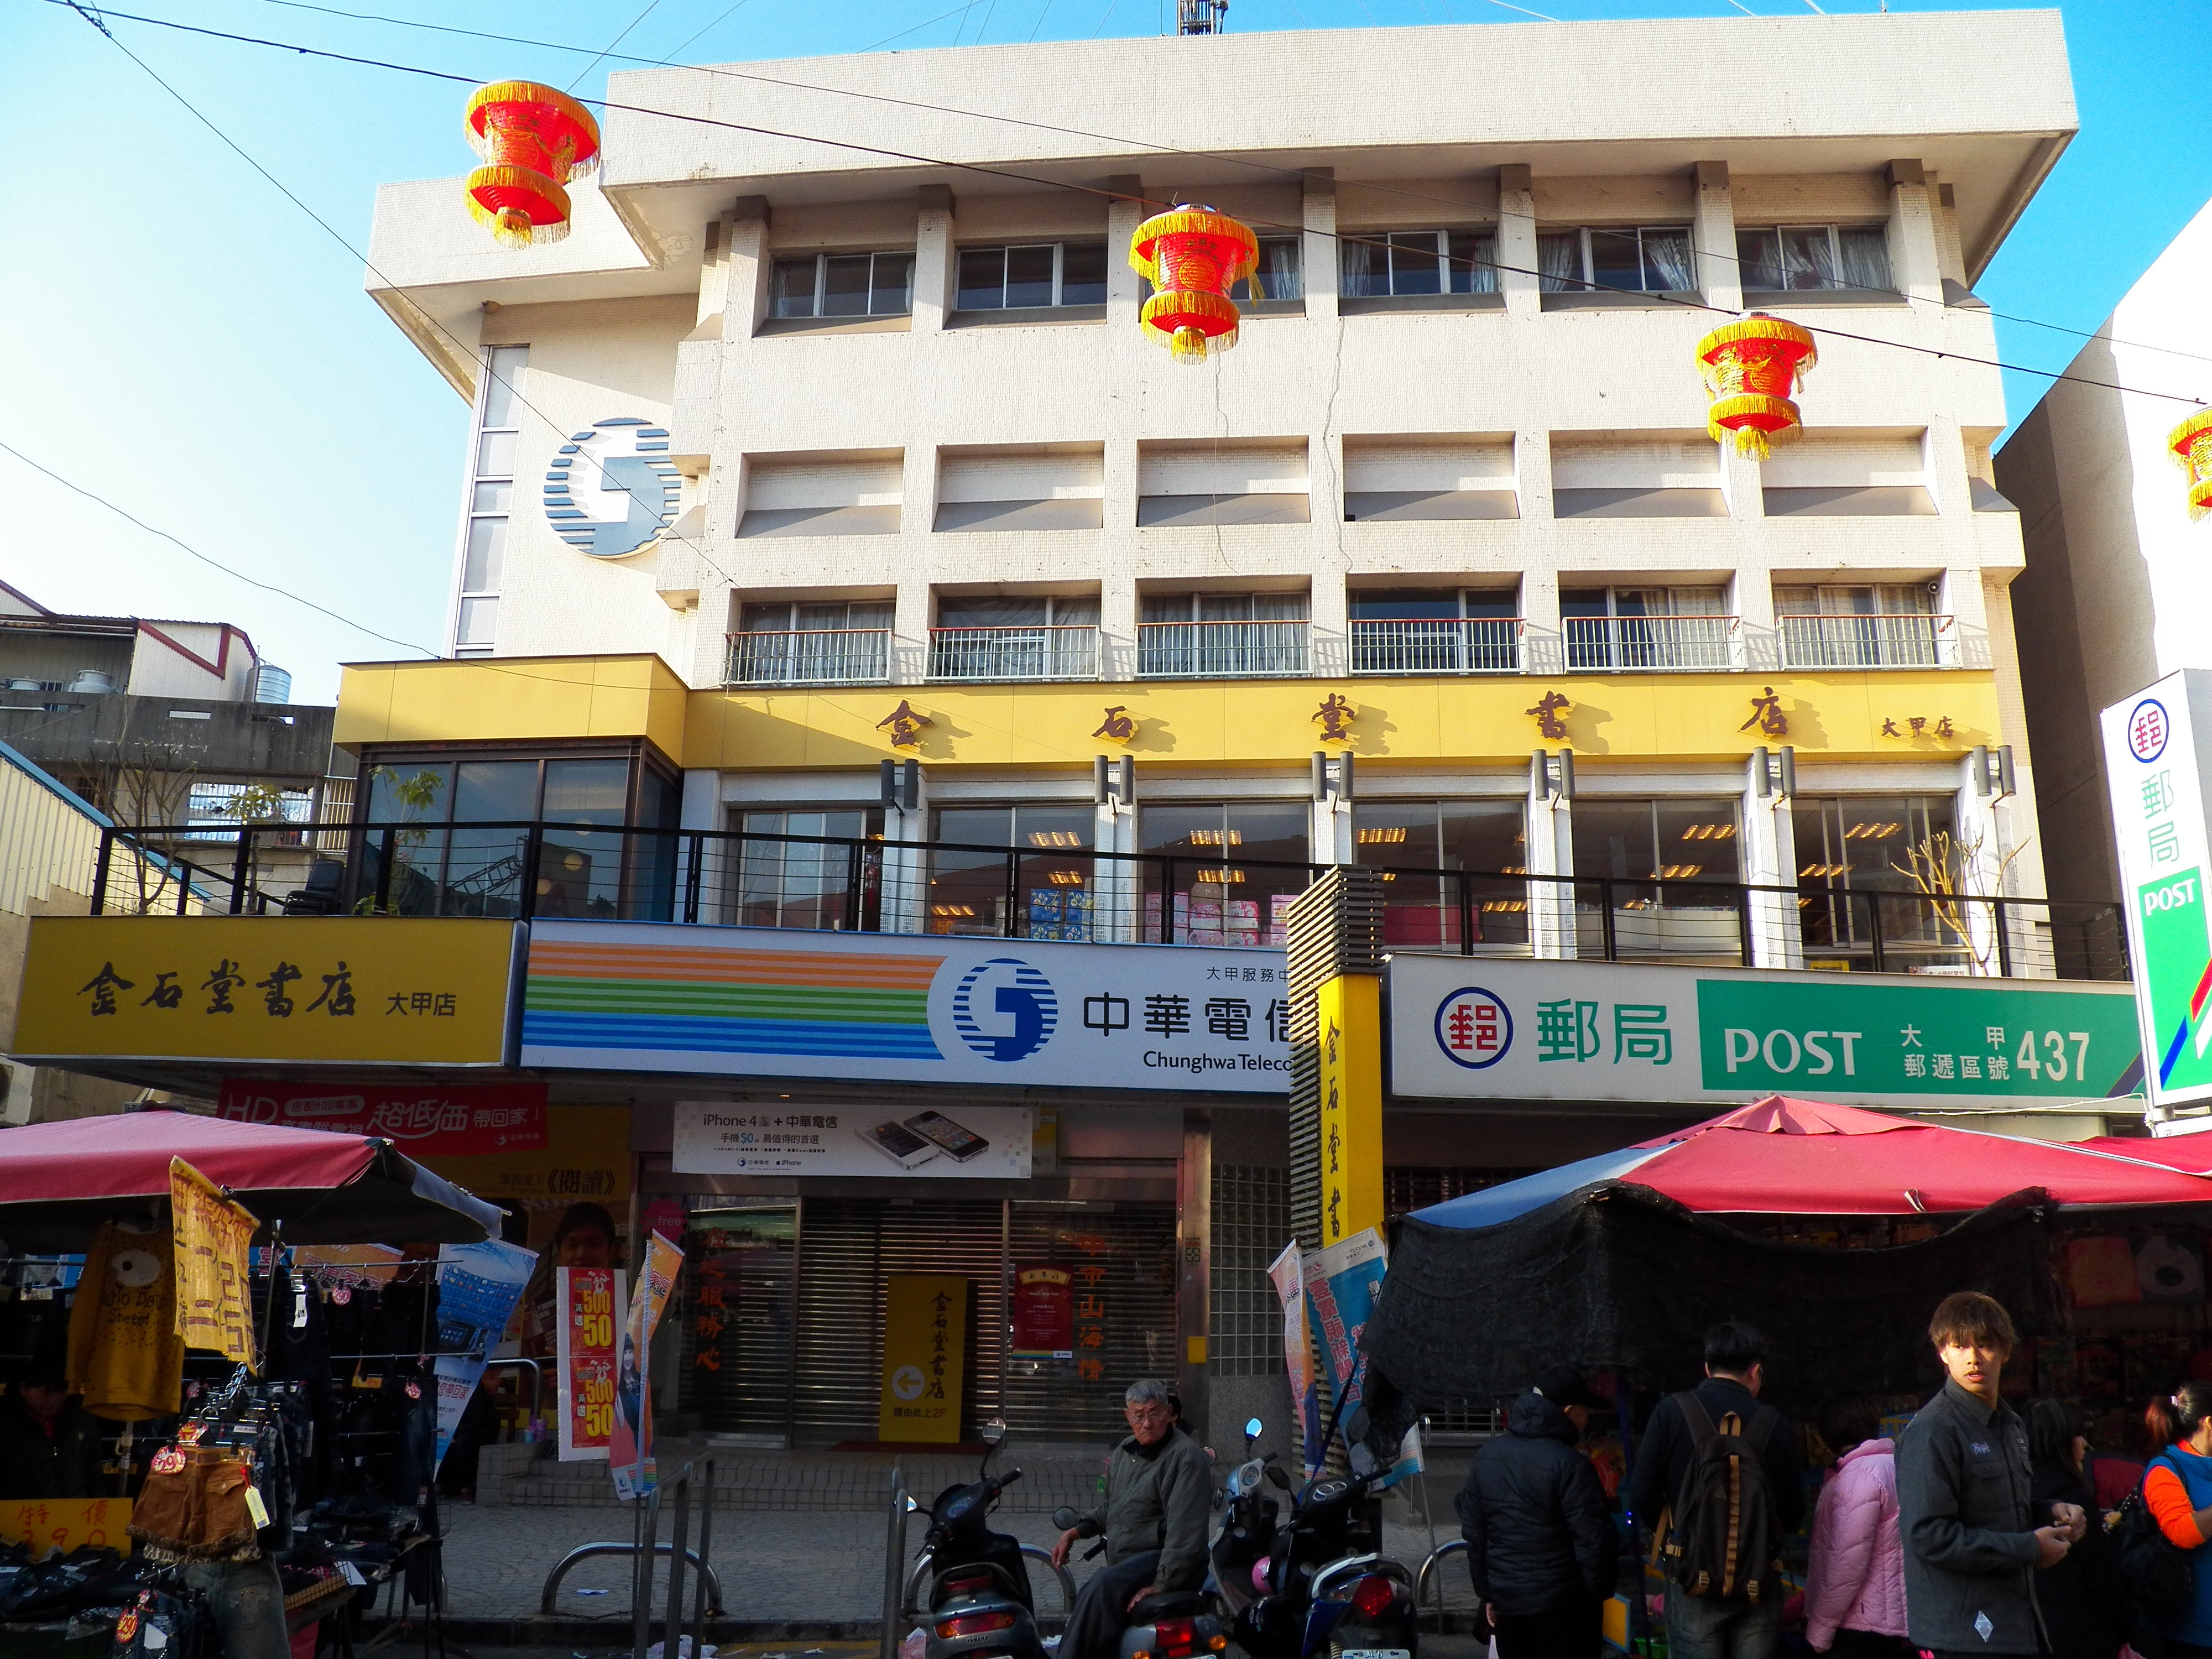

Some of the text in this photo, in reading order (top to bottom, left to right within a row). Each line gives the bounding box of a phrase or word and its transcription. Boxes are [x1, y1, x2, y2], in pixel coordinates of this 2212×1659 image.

[875, 687, 1954, 748] 金石堂書店 大甲店
[2135, 708, 2162, 753] 郵
[2141, 768, 2180, 869] 郵局
[2144, 877, 2196, 916] POST
[78, 959, 457, 1018] 金石堂書店 大甲店
[1448, 1004, 1499, 1051] 郵
[1537, 998, 1673, 1065] 郵局
[1144, 1051, 1237, 1074] Chunghwa
[1724, 1028, 1863, 1076] POST
[1904, 1053, 2010, 1081] 郵遞區號
[2016, 1030, 2090, 1082] 437
[224, 1093, 279, 1124] HD
[703, 1114, 747, 1127] iPhone
[786, 1115, 838, 1129] 中華電信
[762, 1133, 820, 1145] 最值得的首選
[583, 1314, 612, 1348] 50
[925, 1290, 953, 1400] 金石堂書店
[16, 1499, 108, 1526] 特價
[967, 1635, 989, 1644] YAMAHA
